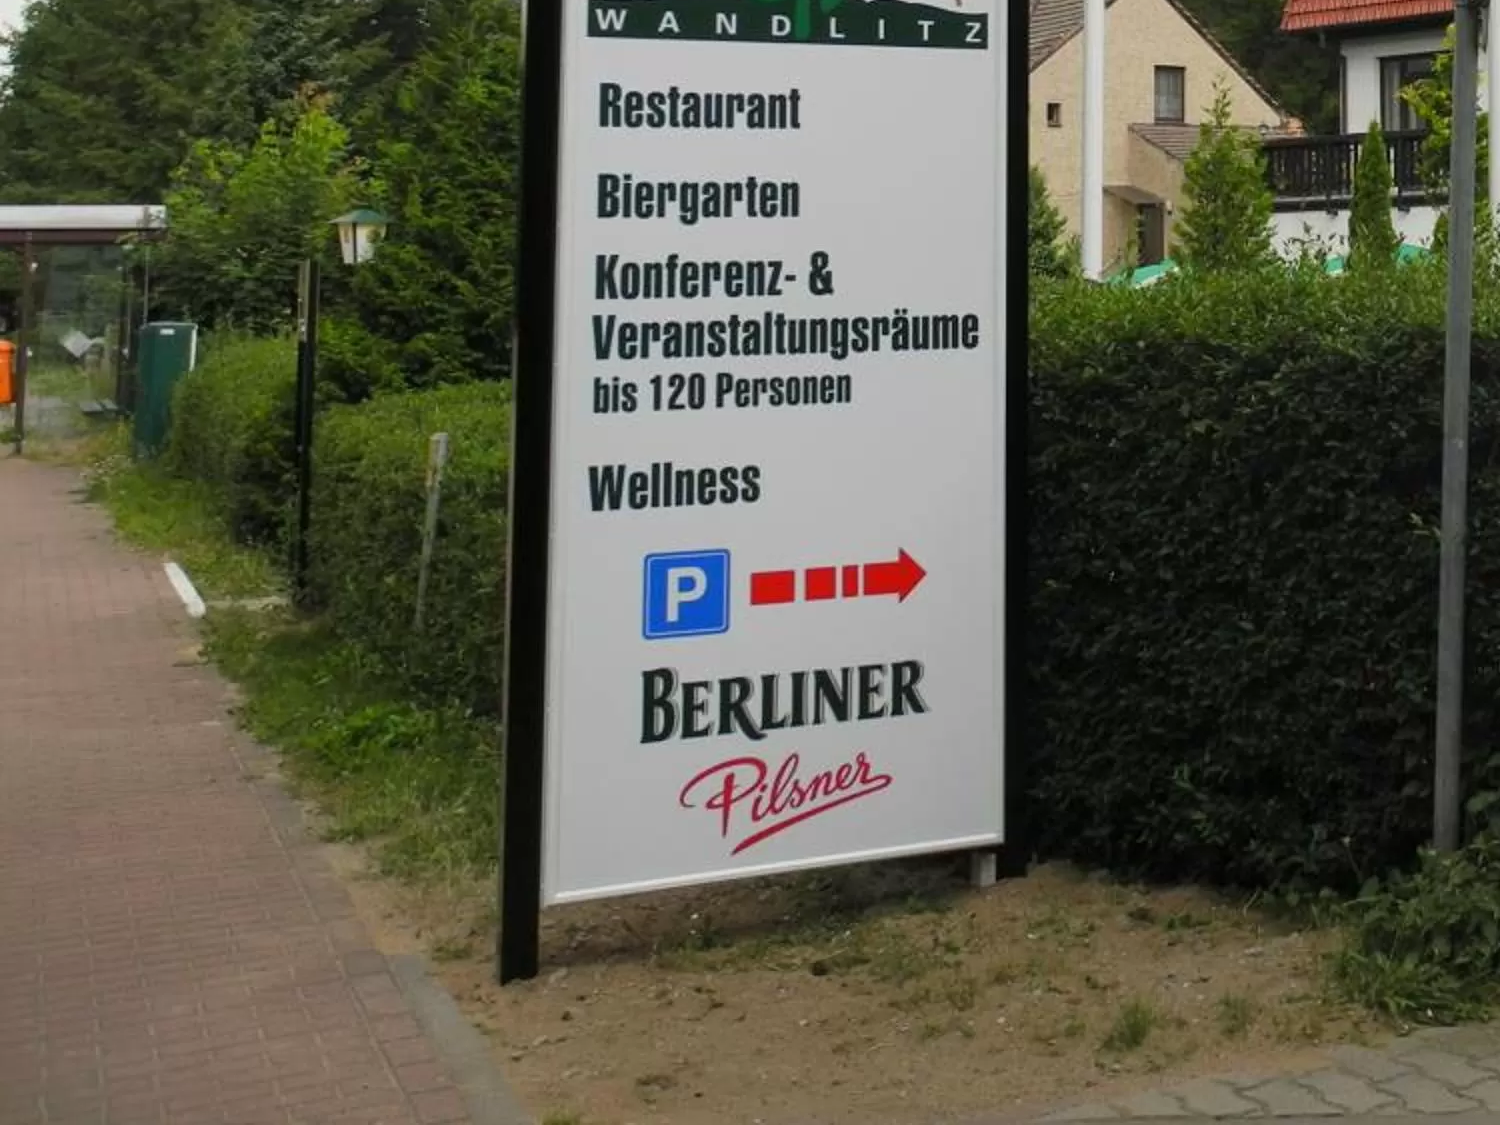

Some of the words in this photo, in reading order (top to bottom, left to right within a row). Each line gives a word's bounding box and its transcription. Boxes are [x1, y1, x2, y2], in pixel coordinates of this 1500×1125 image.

[595, 8, 982, 43] WANDLITZ
[599, 82, 801, 129] Restaurant
[597, 173, 800, 226] Biergarten
[595, 253, 797, 300] Konferenz-
[808, 251, 835, 296] &
[592, 309, 980, 361] Veranstaltungsräume
[593, 376, 638, 413] bis
[649, 373, 706, 412] 120
[715, 372, 852, 409] Personen
[588, 461, 761, 512] Wellness
[664, 565, 708, 622] P
[640, 659, 930, 744] BERLINER
[679, 751, 893, 856] Pilsner
